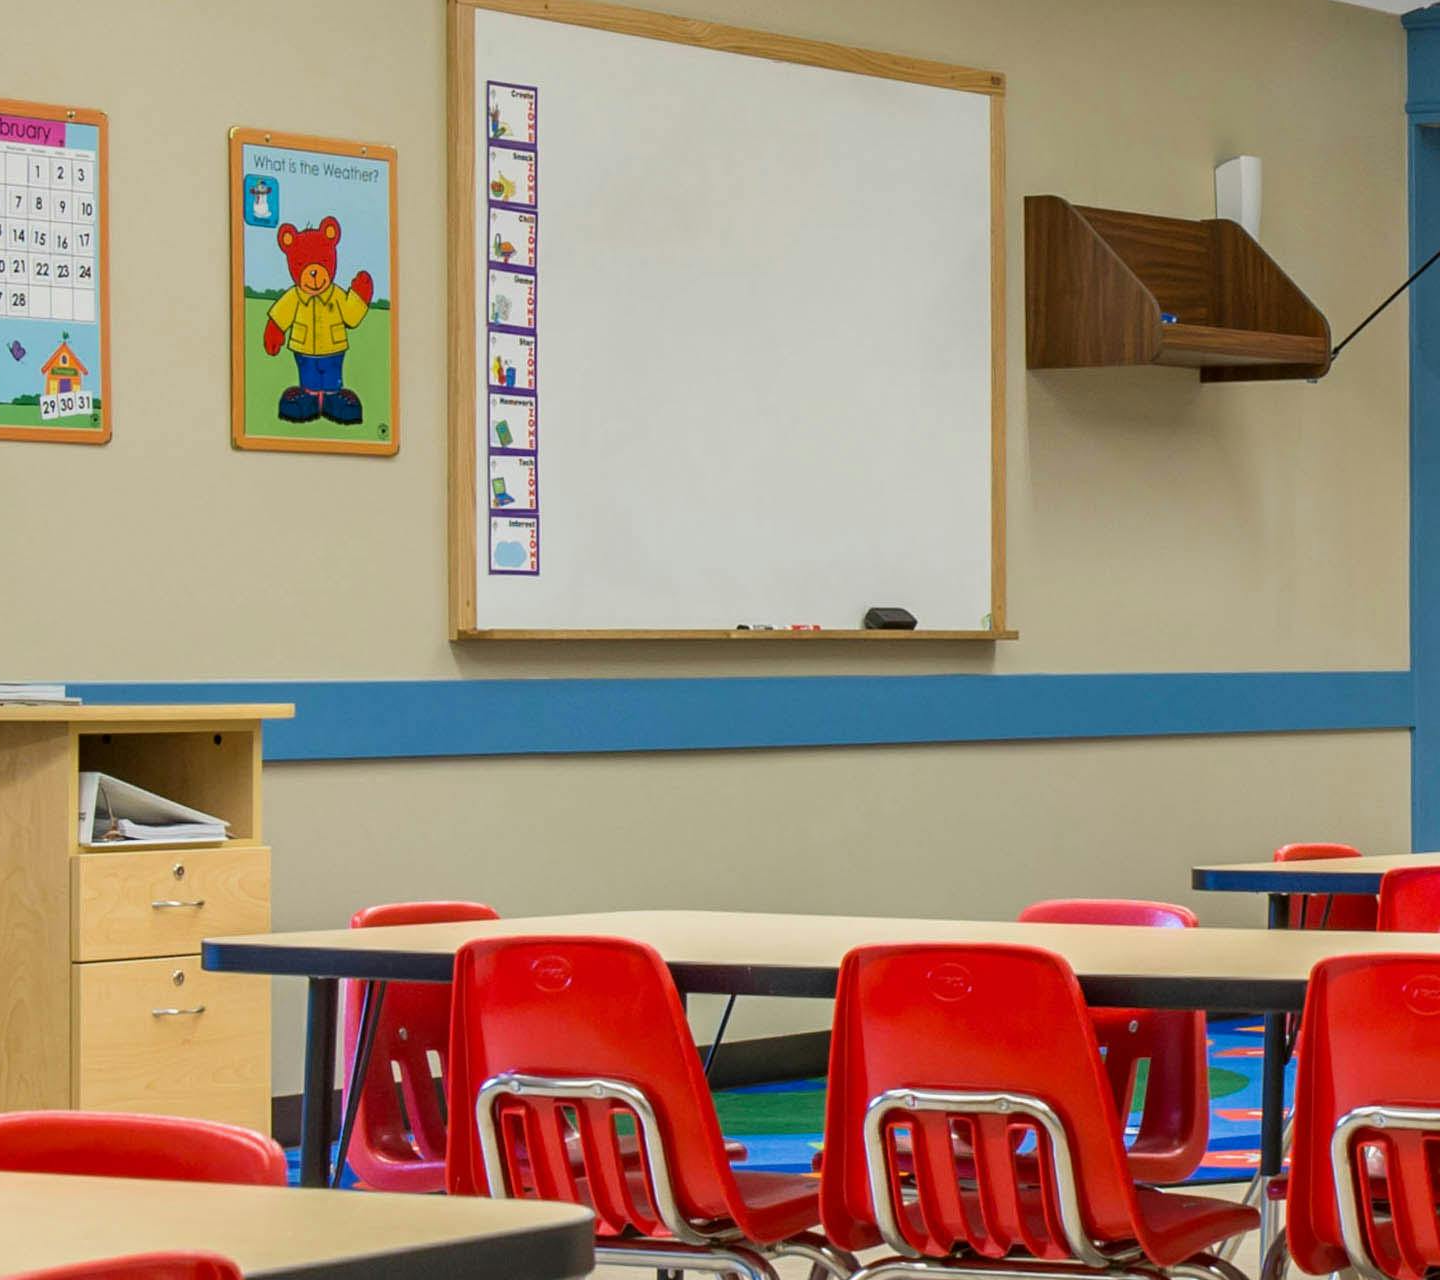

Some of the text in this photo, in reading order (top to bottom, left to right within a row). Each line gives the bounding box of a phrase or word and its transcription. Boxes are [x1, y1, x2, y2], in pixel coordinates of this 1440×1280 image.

[35, 165, 85, 182] 1 2 3
[253, 153, 379, 183] What is the Weather?
[15, 196, 22, 209] 7
[35, 197, 43, 210] 8
[59, 200, 66, 214] 9
[81, 202, 93, 217] 10
[13, 229, 25, 243] 14
[34, 231, 46, 246] 15
[57, 235, 68, 250] 16
[79, 233, 90, 247] 17
[13, 260, 25, 273] 21
[35, 262, 50, 277] 22
[57, 265, 70, 279] 23
[79, 265, 92, 279] 24
[12, 293, 26, 307] 28
[43, 395, 90, 415] 29 30 31
